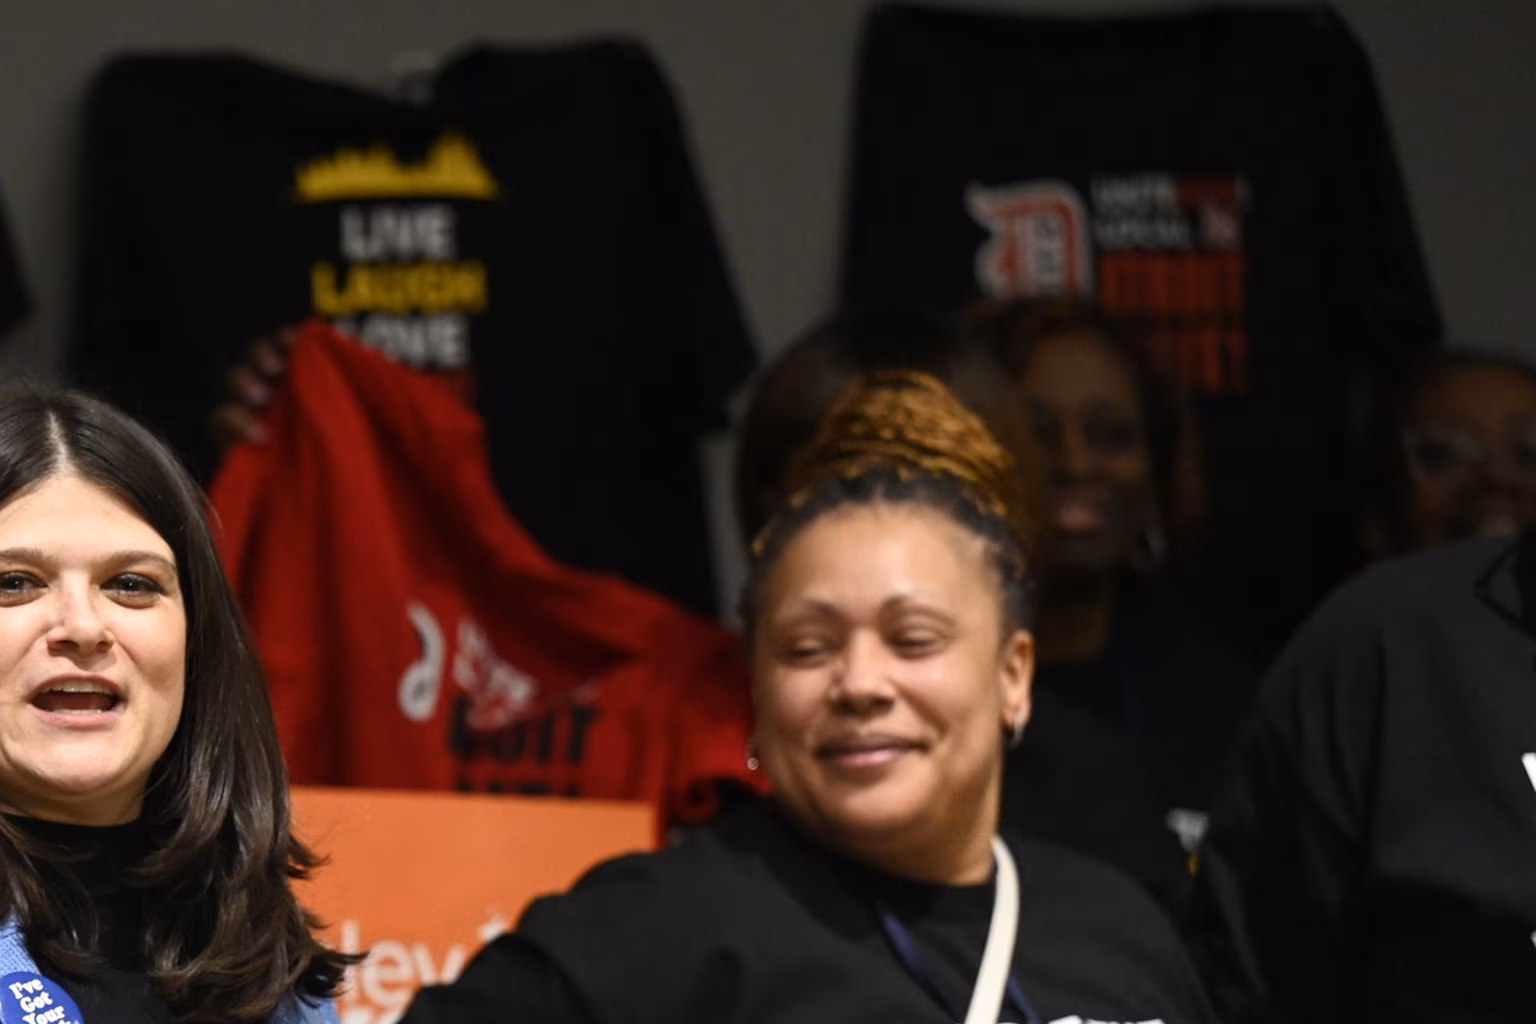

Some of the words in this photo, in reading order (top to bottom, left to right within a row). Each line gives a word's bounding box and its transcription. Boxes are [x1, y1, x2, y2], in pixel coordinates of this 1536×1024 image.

[340, 204, 458, 260] LIVE
[311, 260, 488, 315] LAUGH
[334, 313, 469, 370] OVE
[9, 979, 43, 999] I've
[20, 991, 53, 1013] Got
